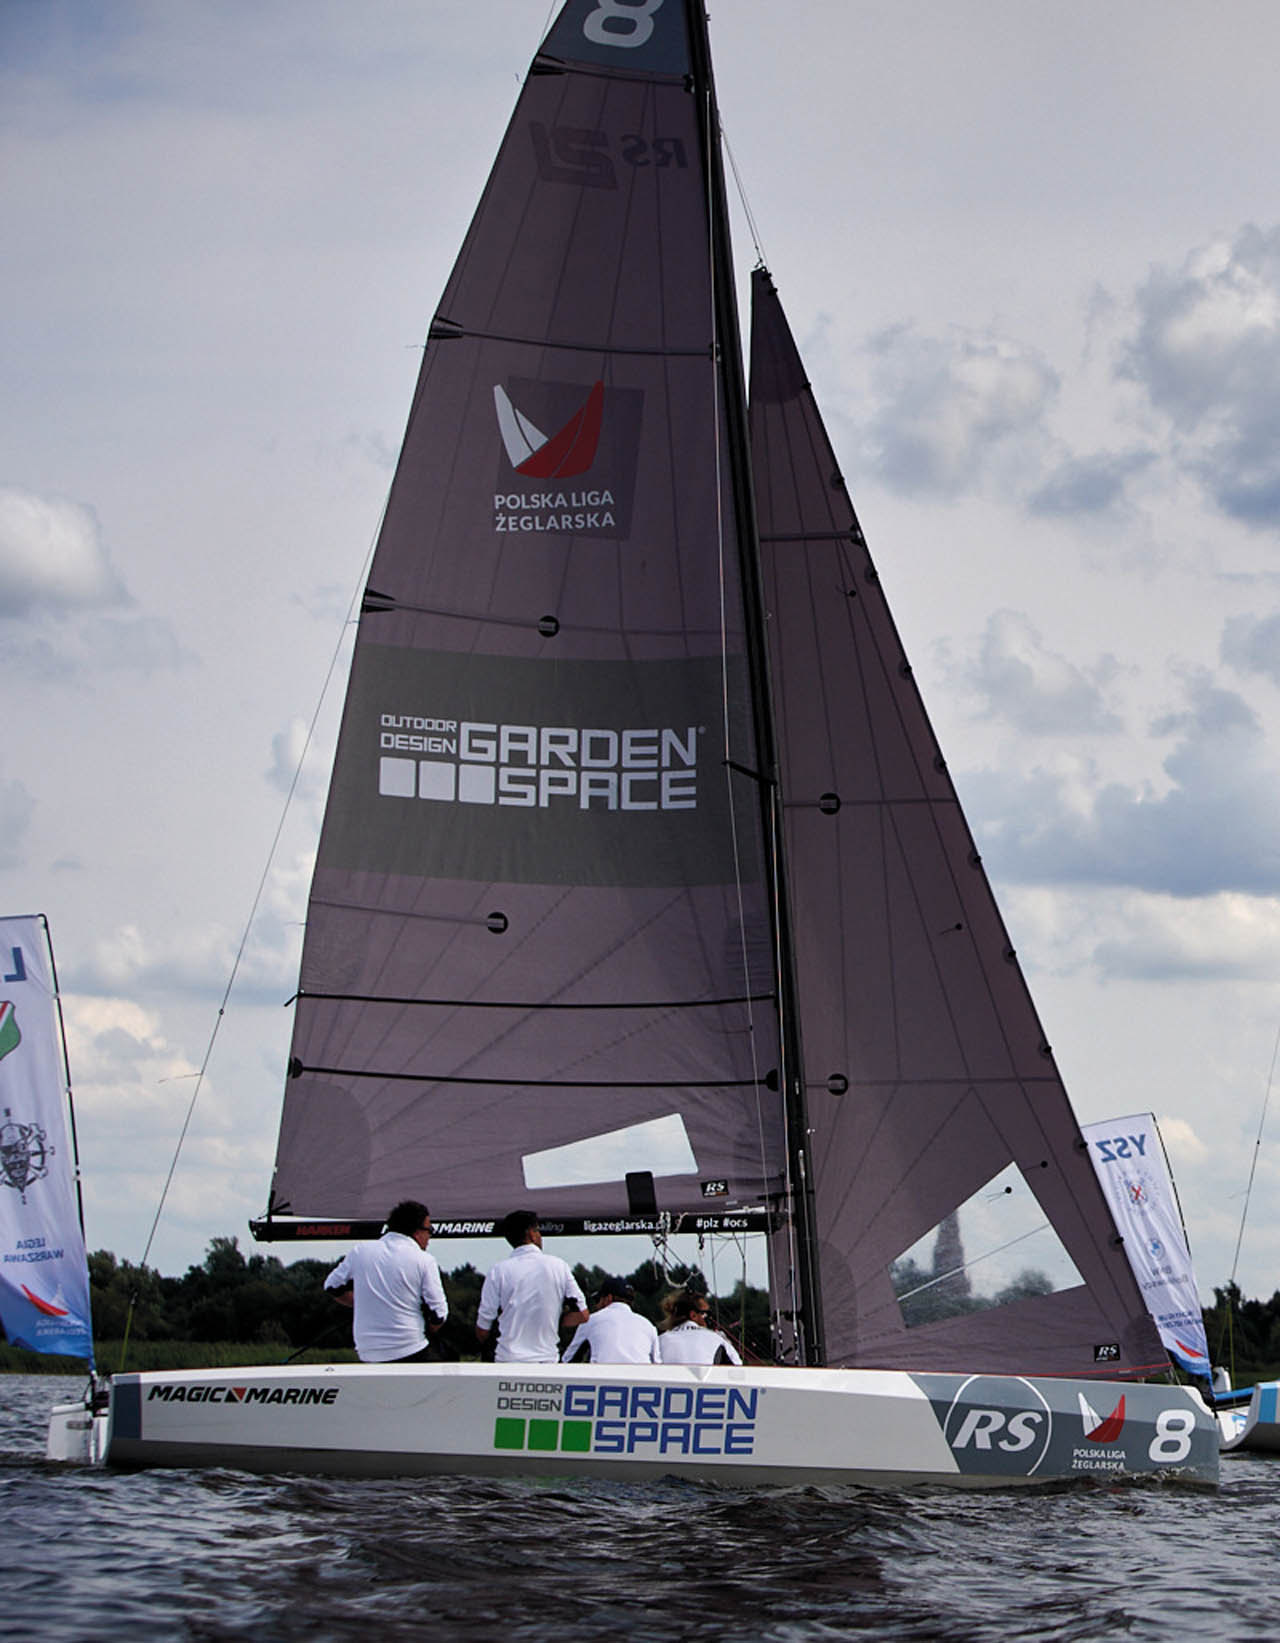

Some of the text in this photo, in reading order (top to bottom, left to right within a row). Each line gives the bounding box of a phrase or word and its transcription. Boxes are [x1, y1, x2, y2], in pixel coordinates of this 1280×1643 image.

[583, 0, 663, 48] 8
[494, 490, 615, 510] POLSKA LIGA
[494, 511, 616, 532] ŻEGLARSKA
[380, 713, 458, 734] OUTDOOR
[380, 732, 458, 754] DESIGN
[459, 721, 697, 769] GARDEN
[498, 766, 697, 810] SPACE
[706, 1181, 725, 1192] RS
[438, 1222, 494, 1233] MARINE
[696, 1217, 748, 1229] #plz #ocs
[1098, 1345, 1117, 1357] RS
[149, 1386, 339, 1405] MAGIC MARINE
[498, 1381, 563, 1394] OUTDOOR
[497, 1397, 562, 1413] DESIGN
[563, 1385, 758, 1420] GARDEN
[594, 1420, 756, 1455] SPACE
[952, 1409, 1043, 1452] RS
[1149, 1409, 1197, 1463] 8
[1072, 1448, 1127, 1459] POLSKA LIGA
